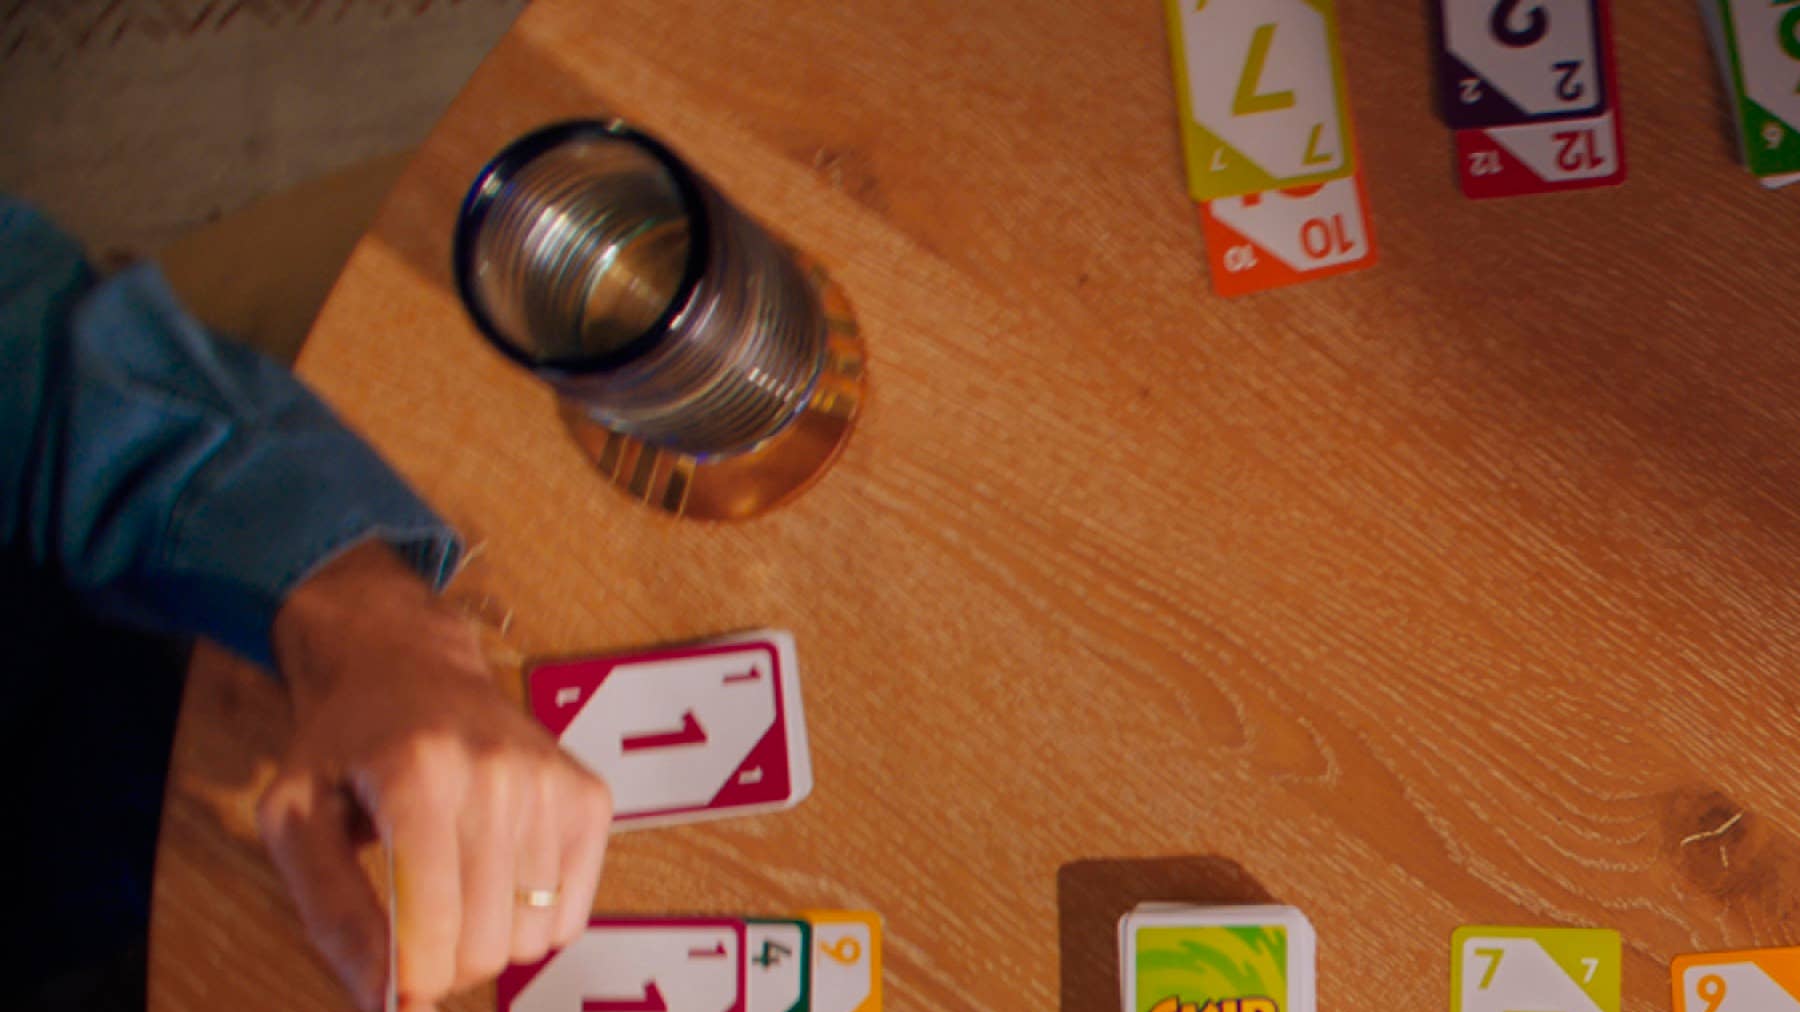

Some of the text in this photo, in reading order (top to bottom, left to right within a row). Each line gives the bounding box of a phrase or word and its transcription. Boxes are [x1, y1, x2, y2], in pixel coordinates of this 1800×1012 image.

[1231, 22, 1296, 117] 7
[1552, 60, 1584, 101] 2
[1302, 122, 1333, 166] 7
[1468, 149, 1504, 177] 12
[1554, 129, 1604, 172] 12
[1301, 213, 1354, 259] 10
[722, 663, 762, 684] 1
[621, 707, 707, 754] 1
[688, 941, 727, 959] 1
[753, 940, 792, 969] 4
[1473, 948, 1504, 990] 7
[1580, 958, 1598, 982] 7
